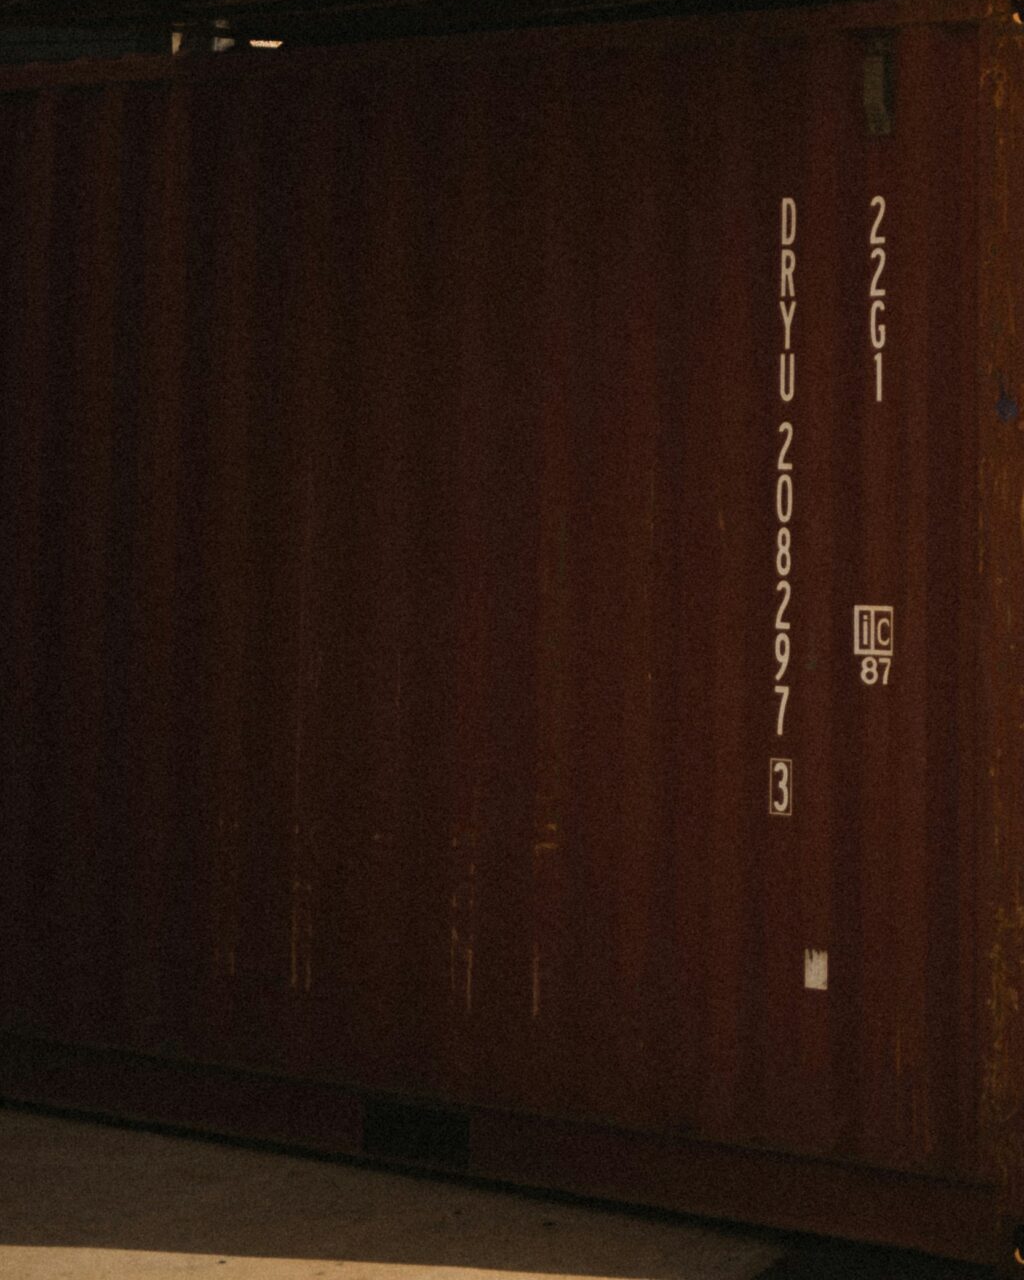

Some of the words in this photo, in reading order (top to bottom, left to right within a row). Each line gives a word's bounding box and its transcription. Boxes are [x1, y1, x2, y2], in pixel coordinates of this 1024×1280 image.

[779, 197, 797, 403] DRYU
[870, 196, 887, 402] 22G1
[774, 421, 794, 736] 208297
[861, 656, 892, 685] 87
[771, 760, 790, 814] 3
